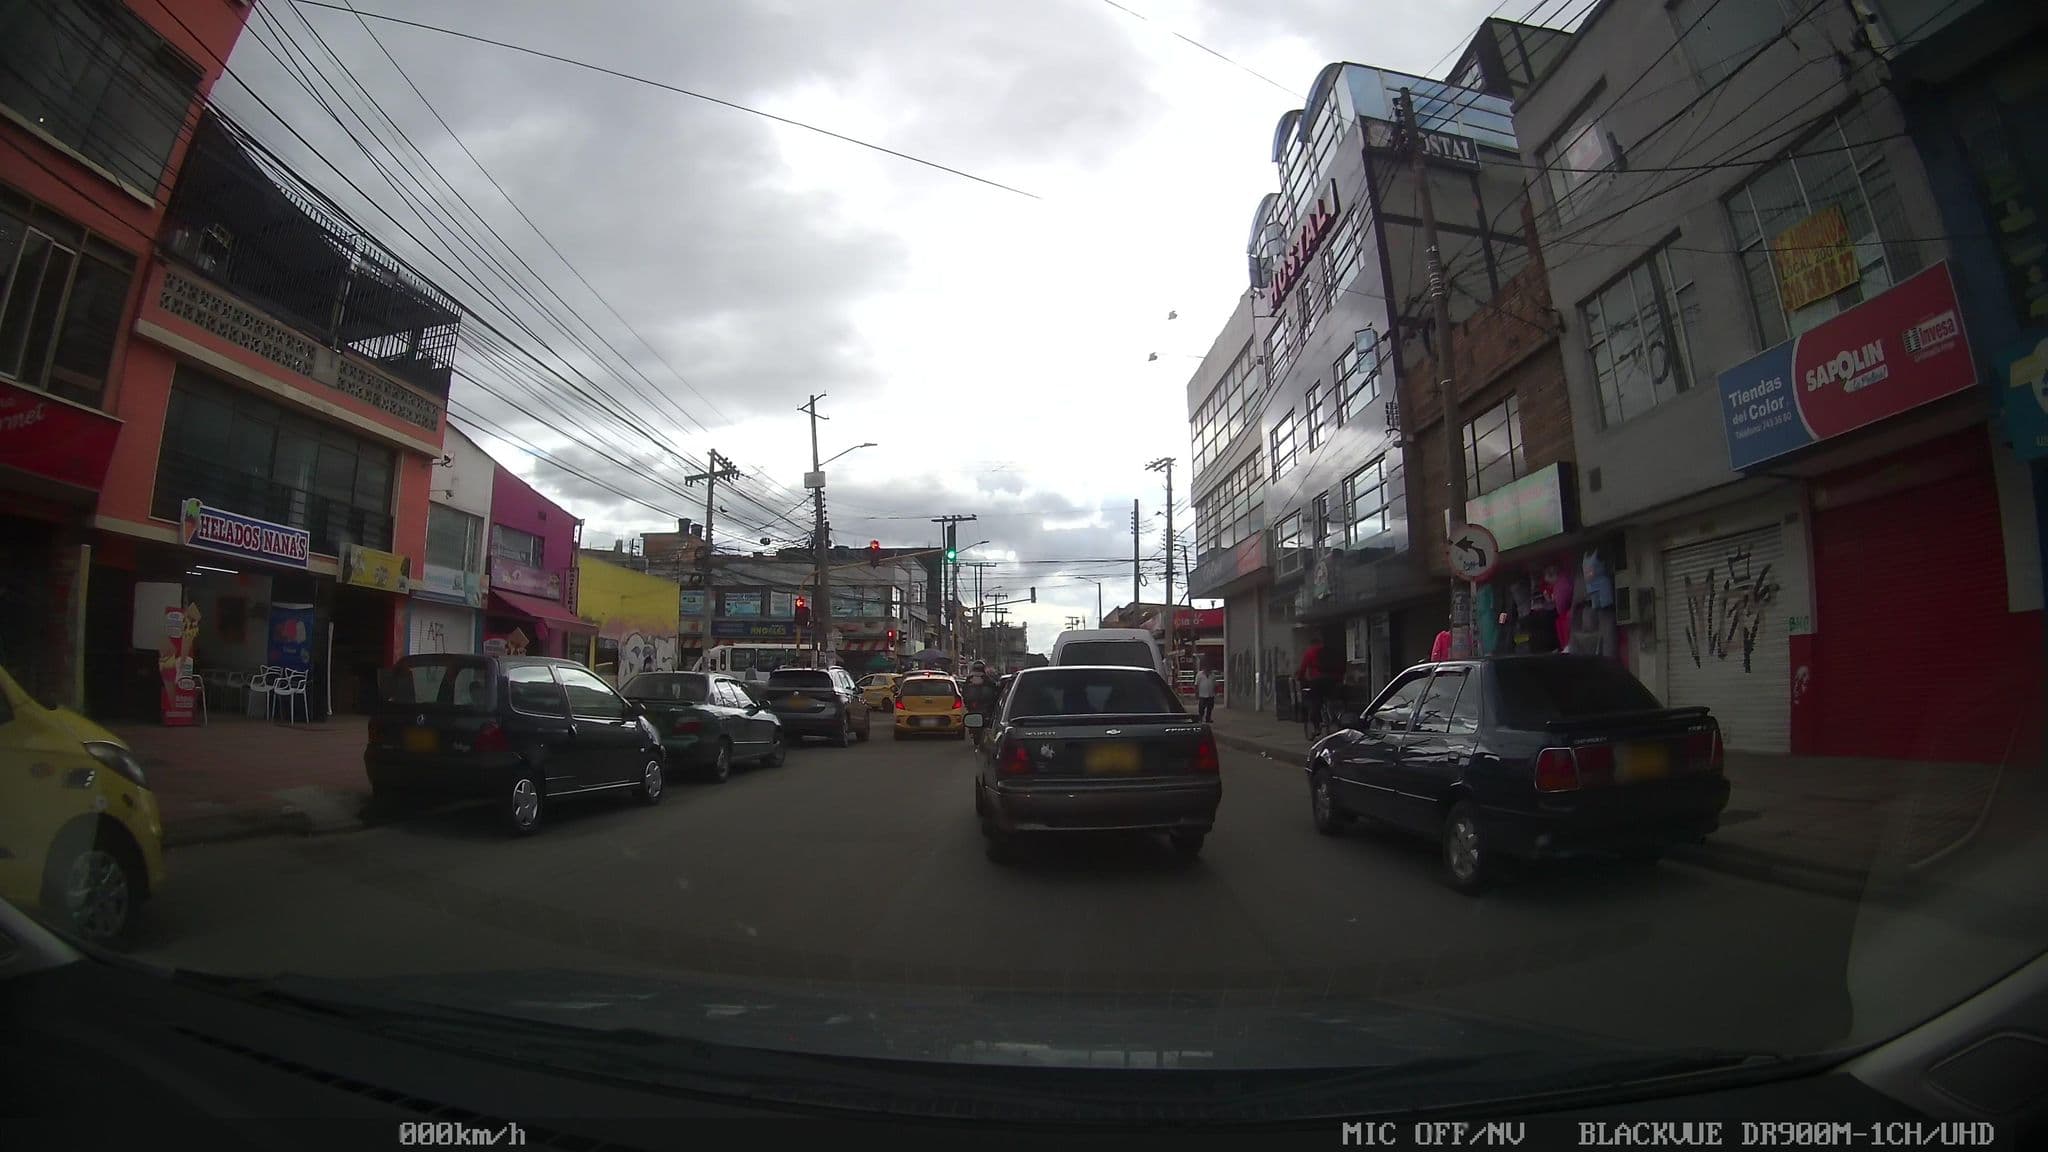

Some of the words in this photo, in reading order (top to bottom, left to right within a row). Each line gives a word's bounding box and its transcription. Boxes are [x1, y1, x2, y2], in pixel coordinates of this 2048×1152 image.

[1268, 199, 1330, 306] HOSTAL
[1918, 318, 1955, 346] invesa
[1805, 339, 1885, 392] SAPOLIN
[1728, 375, 1783, 409] Tiendas
[1732, 409, 1748, 425] del
[1748, 396, 1785, 421] Color
[198, 515, 261, 551] HELADOS
[262, 528, 306, 561] NANA'S
